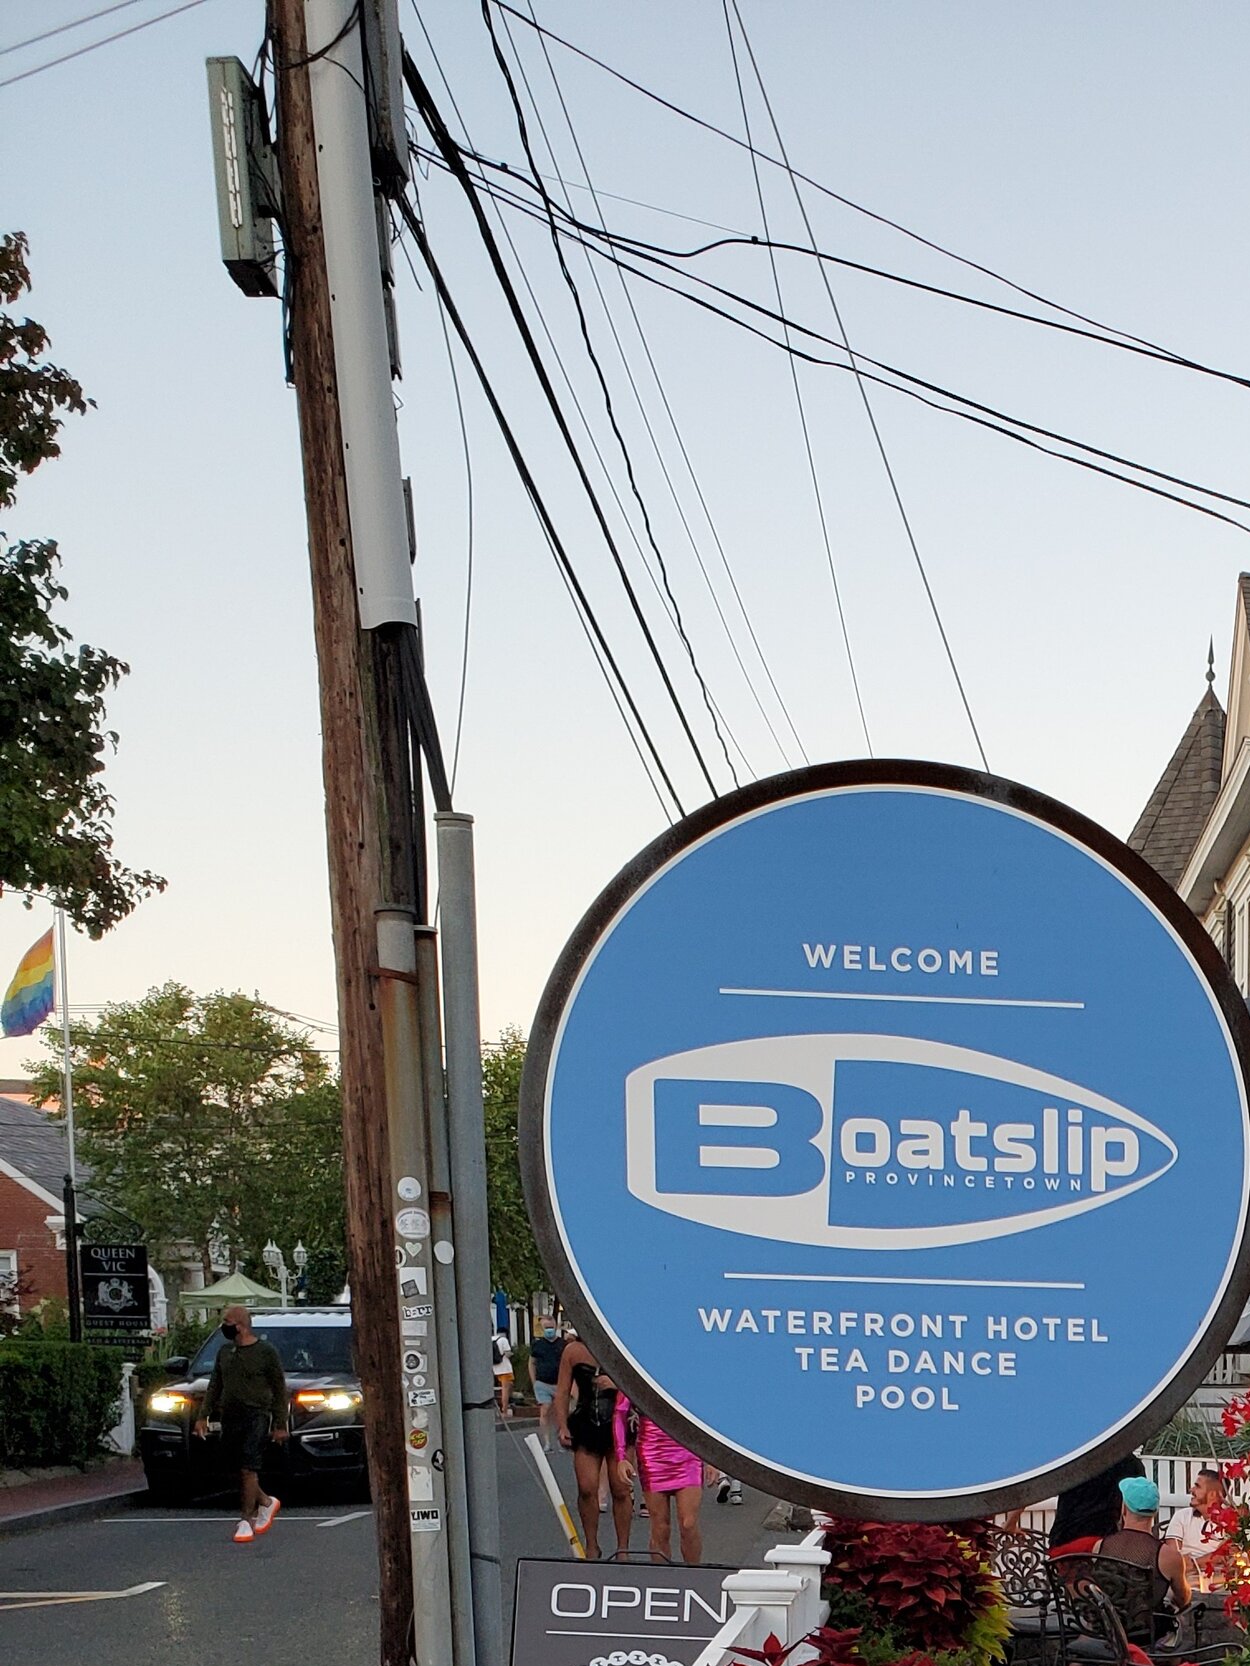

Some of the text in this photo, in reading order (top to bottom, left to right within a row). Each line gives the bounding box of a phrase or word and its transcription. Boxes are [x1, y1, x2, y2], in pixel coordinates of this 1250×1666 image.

[803, 944, 999, 975] WELCOME
[654, 1079, 1140, 1197] Boatslip
[846, 1171, 1083, 1191] PROVINCETOWN
[91, 1248, 135, 1260] QUEEN
[102, 1261, 126, 1272] VIC
[698, 1308, 1109, 1343] WATERFRONT HOTEL
[795, 1347, 1017, 1376] TEA DANCE
[856, 1385, 960, 1411] POOL
[550, 1582, 728, 1625] OPEN
